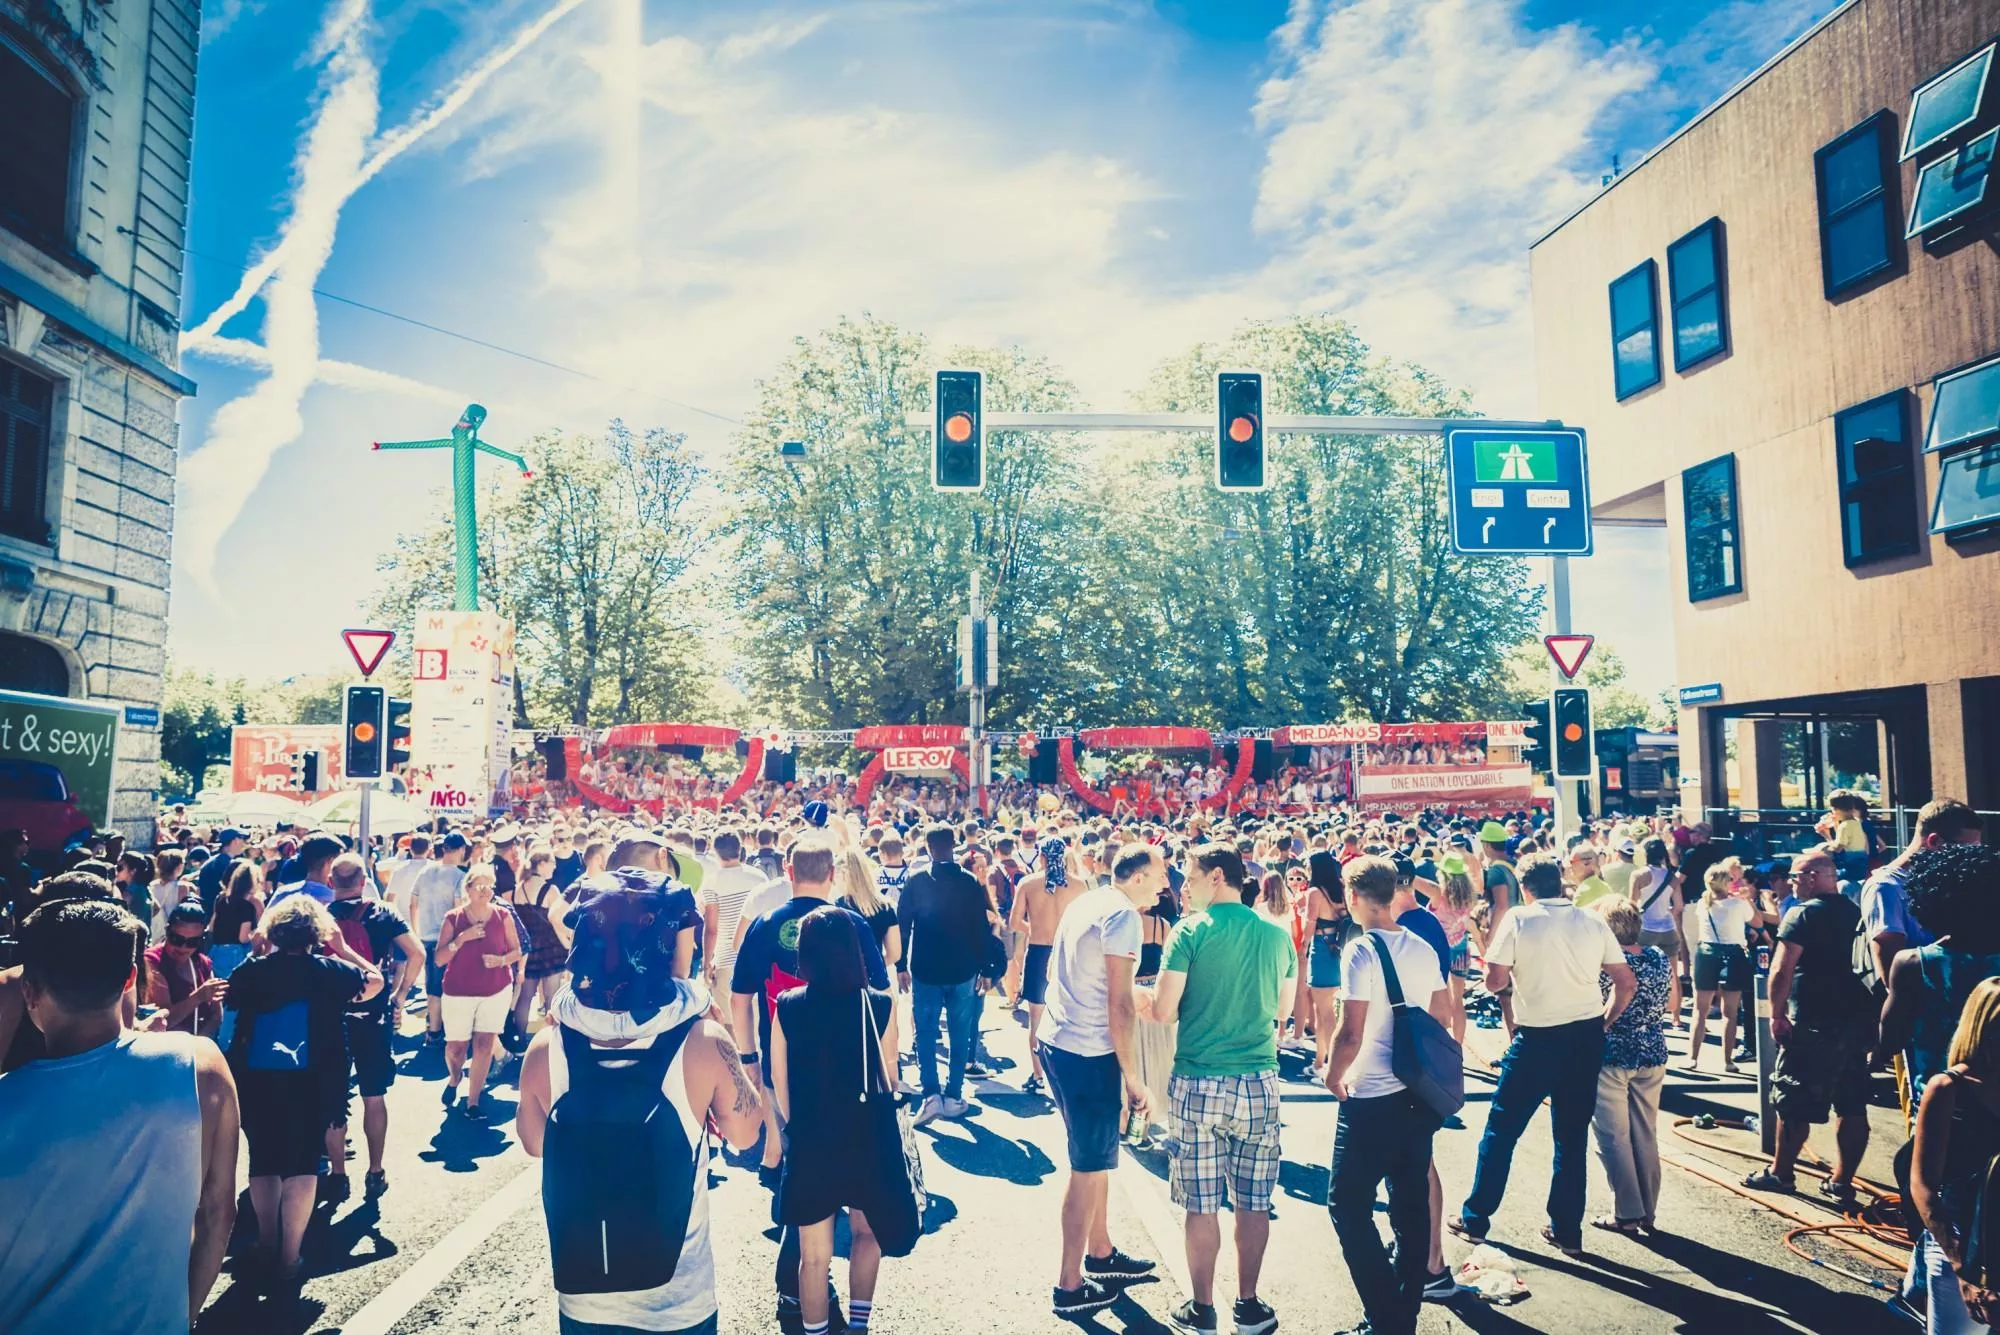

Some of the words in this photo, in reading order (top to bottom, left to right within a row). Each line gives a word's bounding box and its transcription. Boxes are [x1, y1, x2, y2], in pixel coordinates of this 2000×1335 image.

[1489, 724, 1507, 736] ONE
[19, 714, 42, 752] &
[48, 723, 112, 768] sexy!
[886, 750, 952, 768] LEEROY
[1391, 777, 1411, 790] ONE
[1412, 775, 1445, 788] NATION
[1447, 772, 1505, 787] LOVEMOBILE
[430, 790, 466, 807] INFO
